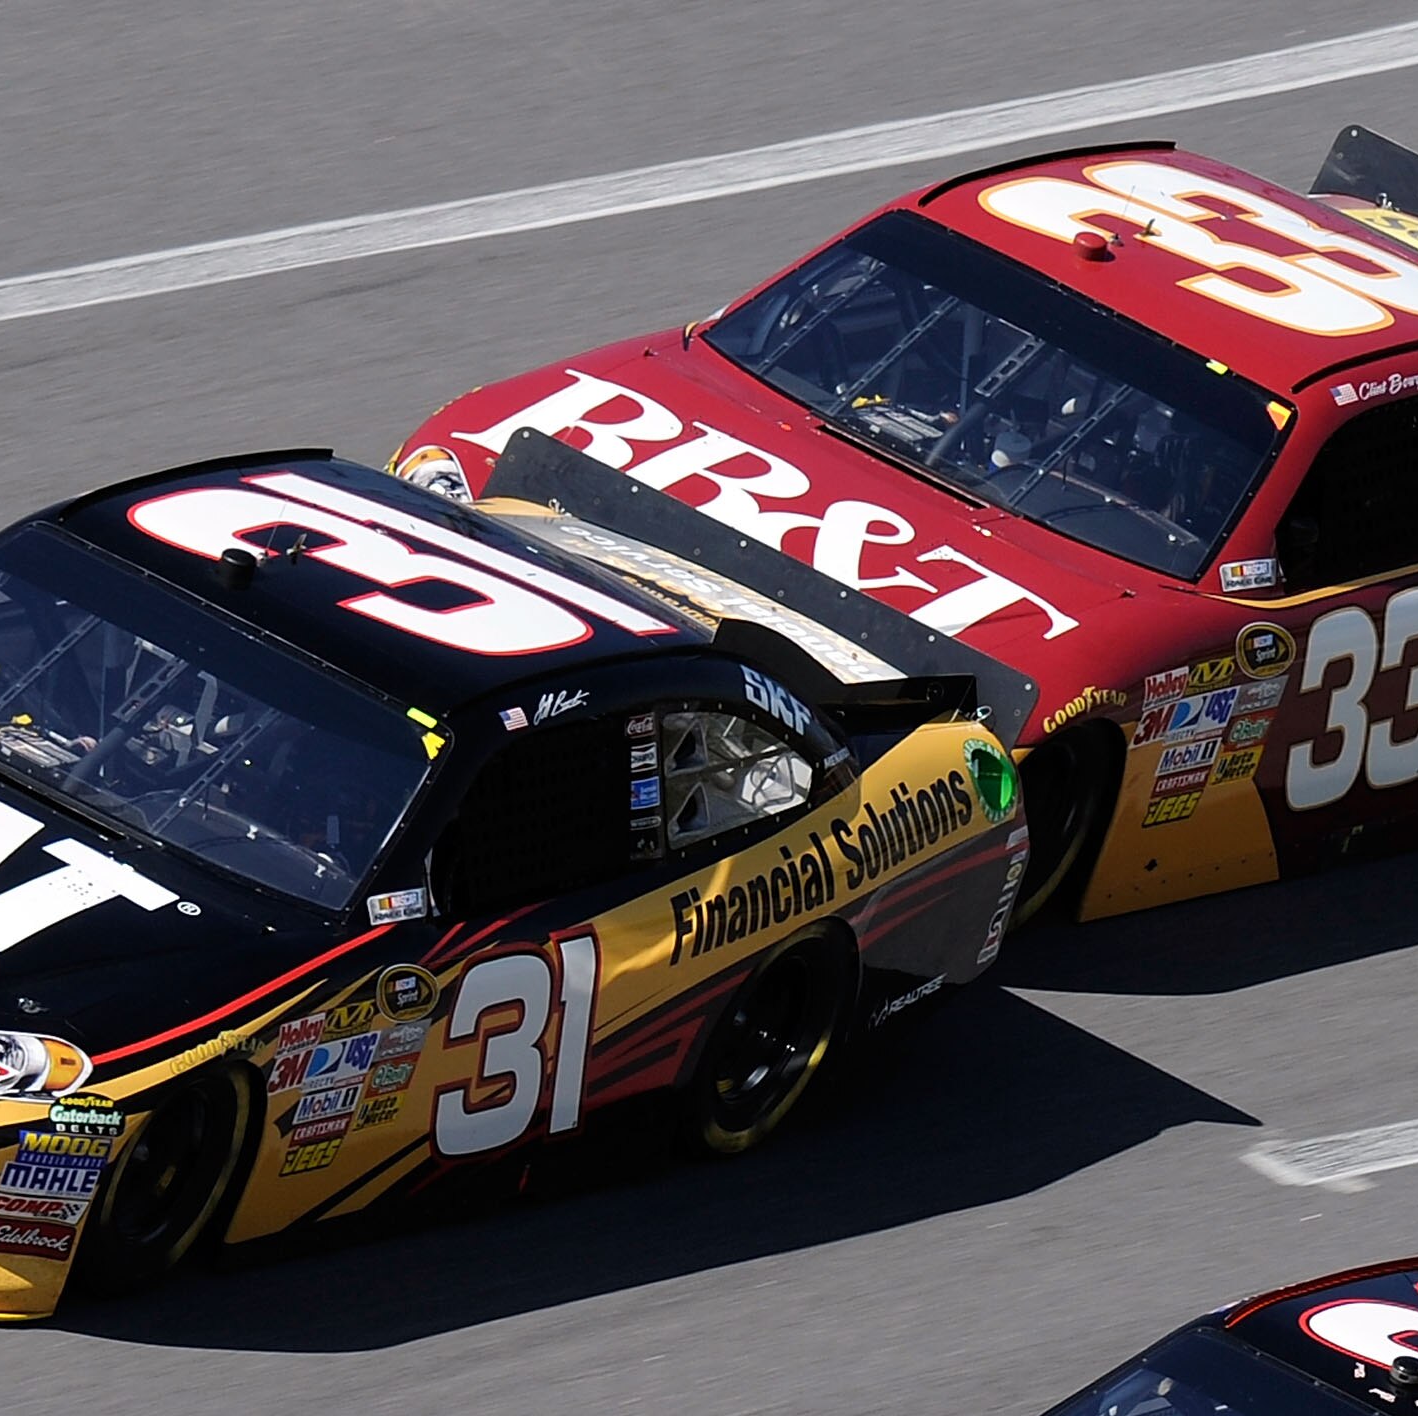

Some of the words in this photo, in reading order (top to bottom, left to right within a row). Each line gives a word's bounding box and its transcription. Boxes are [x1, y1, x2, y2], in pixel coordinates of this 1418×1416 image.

[452, 369, 1080, 641] BB&T
[126, 472, 680, 656] 31
[739, 663, 813, 736] SKF
[1043, 686, 1128, 733] GOODYEAR
[1133, 704, 1176, 746] 3M
[1160, 745, 1200, 770] Mobil
[1201, 738, 1218, 761] 1
[1155, 769, 1209, 793] CRAFTSMAN
[1144, 792, 1203, 828] JEGS
[671, 832, 835, 966] Financial
[831, 770, 973, 891] Solutions
[281, 1019, 325, 1048] Holley
[345, 1032, 378, 1070] USG
[431, 925, 600, 1160] 31
[268, 1050, 314, 1094] 3M
[50, 1105, 124, 1126] Gatorback
[298, 1091, 341, 1120] Mobil
[341, 1086, 360, 1108] 1
[21, 1132, 112, 1158] MOOG
[55, 1123, 118, 1136] BELTS
[293, 1117, 349, 1140] CRAFTSMAN
[282, 1138, 343, 1175] JEGS
[1, 1163, 99, 1194] MAHLE
